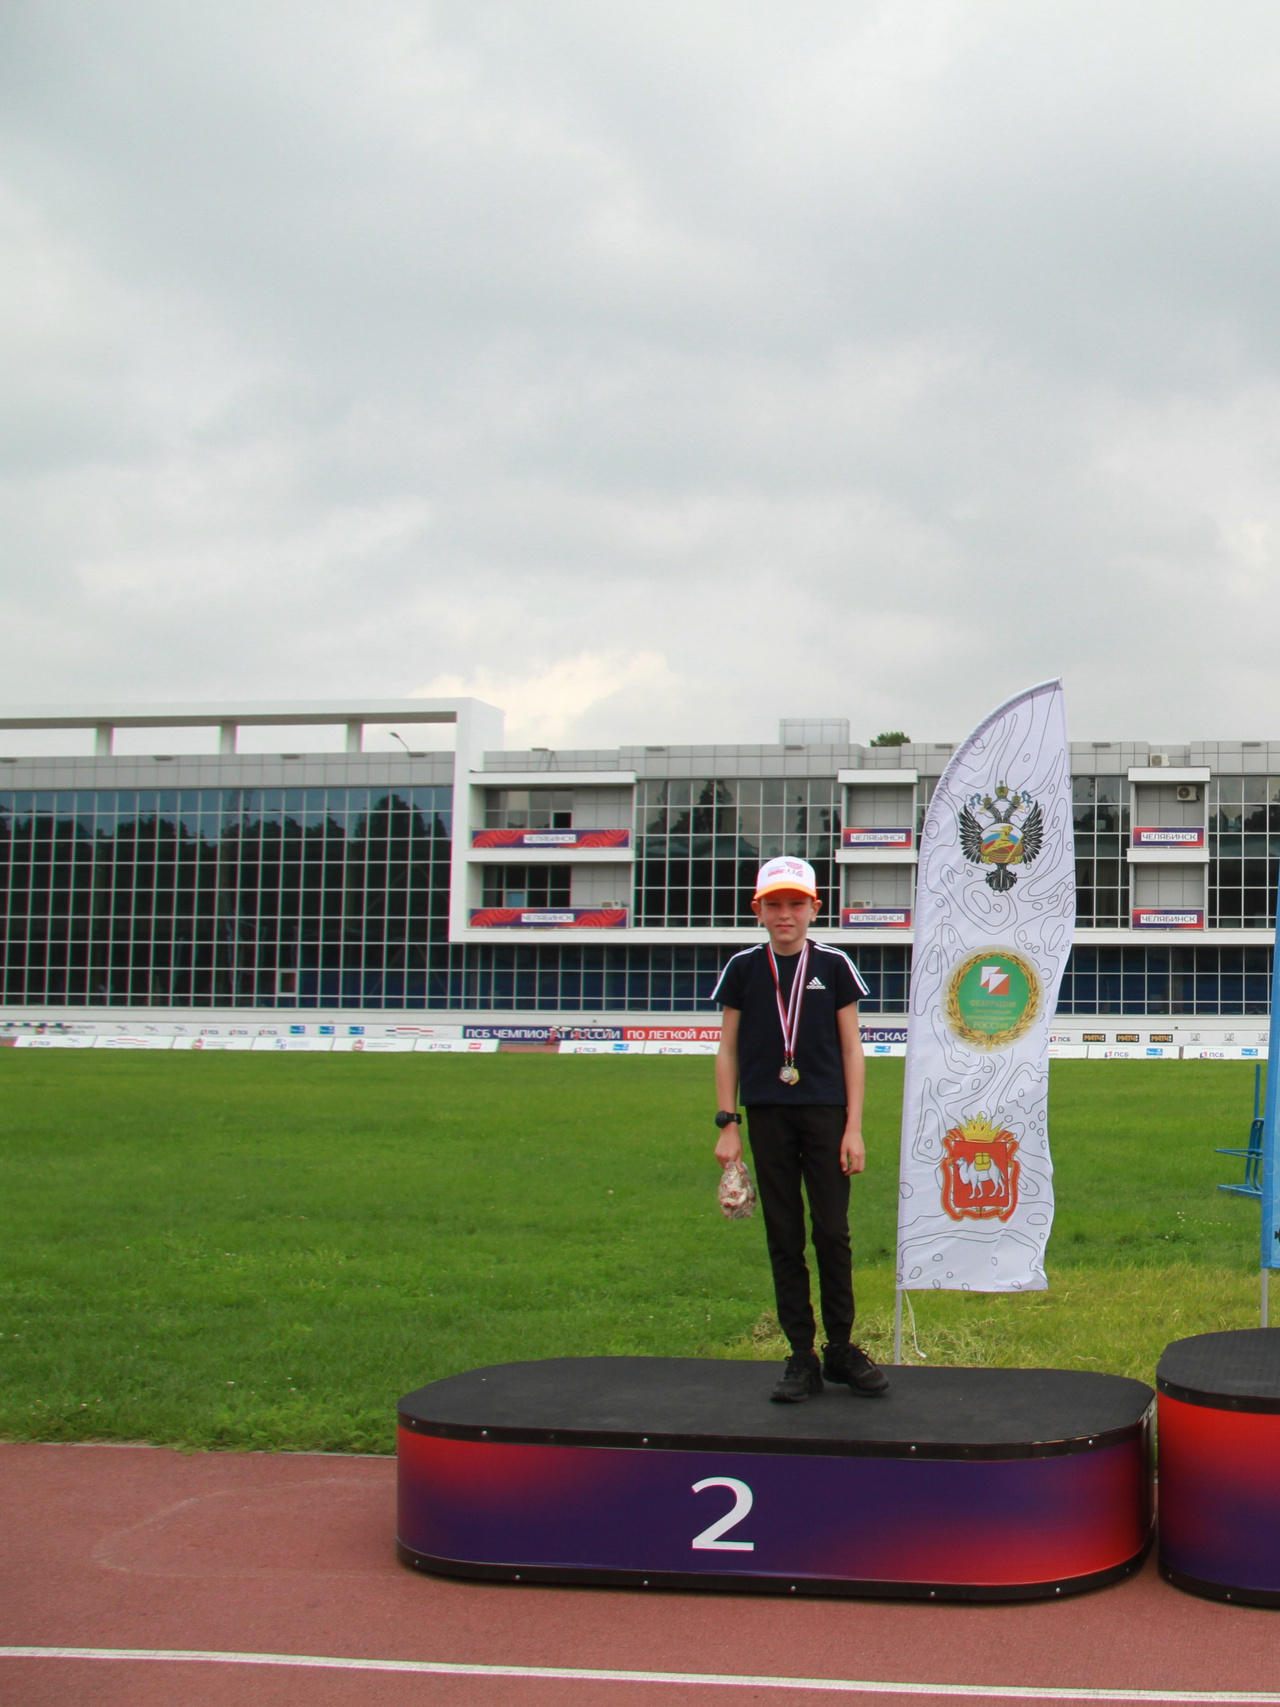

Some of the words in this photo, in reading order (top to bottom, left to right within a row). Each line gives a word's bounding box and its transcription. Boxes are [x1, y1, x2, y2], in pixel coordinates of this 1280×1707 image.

[1141, 915, 1196, 923] ЧЕЛЯБИНСК
[466, 1029, 490, 1038] ПСБ
[493, 1029, 566, 1039] ЧЕМПИОНАТ
[627, 1030, 645, 1039] ПО
[648, 1028, 697, 1039] ЛЕГКОЙ
[700, 1030, 722, 1039] АТЛ
[859, 1031, 908, 1041] ИНСКАЯ
[691, 1476, 754, 1551] 2
